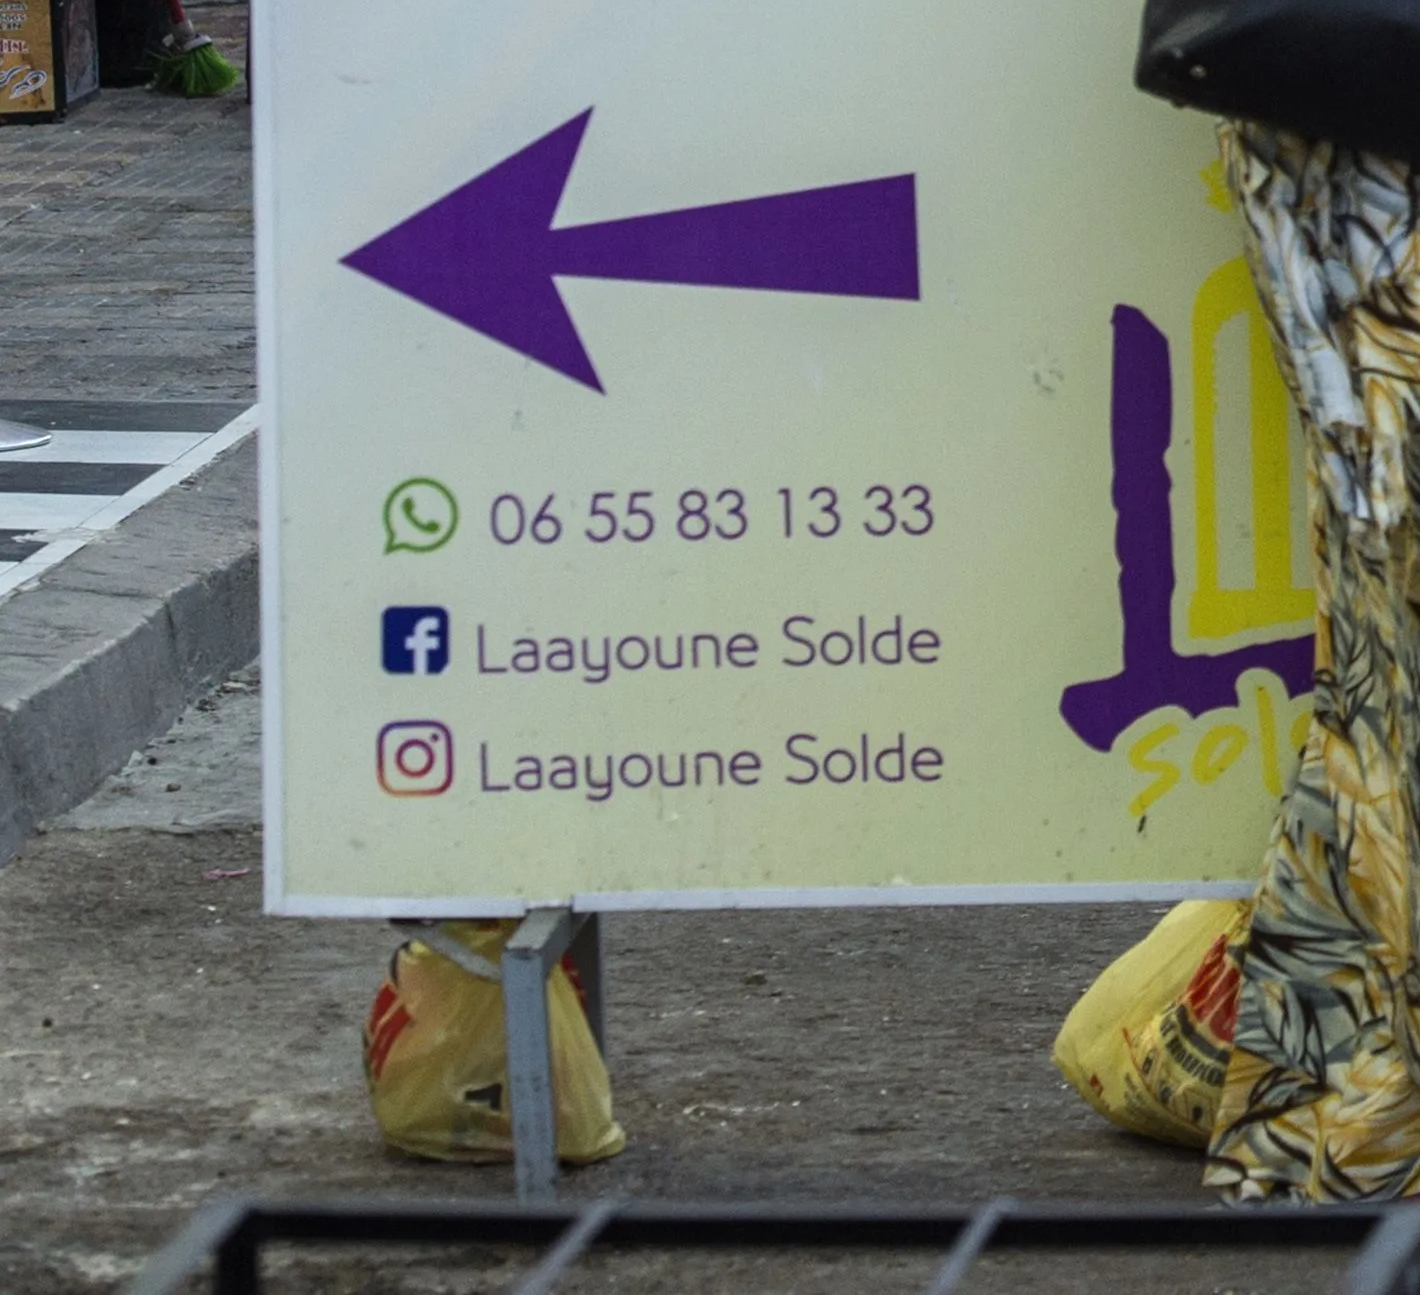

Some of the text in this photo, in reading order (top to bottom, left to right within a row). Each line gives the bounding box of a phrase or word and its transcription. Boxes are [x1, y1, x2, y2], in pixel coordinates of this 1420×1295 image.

[490, 483, 934, 546] 06 55 83 13 33
[477, 624, 759, 684] Laayoune
[782, 614, 942, 667] Solde
[479, 732, 944, 803] Laayoune Solde
